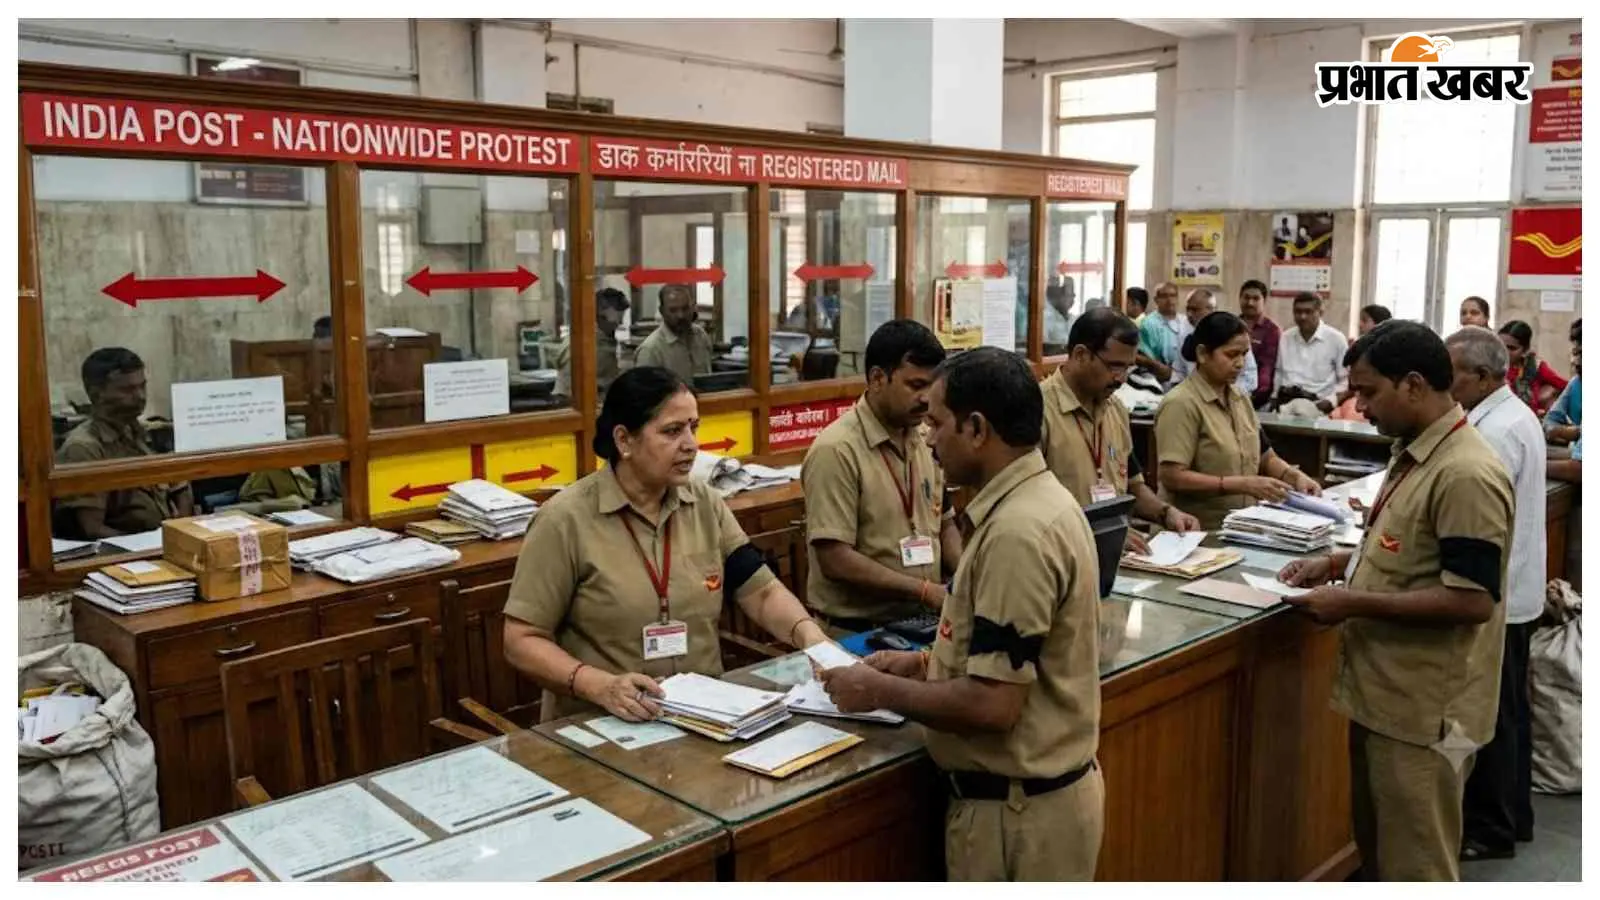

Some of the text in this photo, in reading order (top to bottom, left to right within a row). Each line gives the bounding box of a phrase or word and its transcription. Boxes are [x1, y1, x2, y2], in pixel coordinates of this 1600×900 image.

[43, 101, 571, 166] INDIA POST - NATIONWIDE PROTEST
[597, 143, 640, 169] डाक
[762, 153, 863, 183] REGISTERED
[867, 160, 902, 184] MAIL
[144, 836, 201, 859] POST
